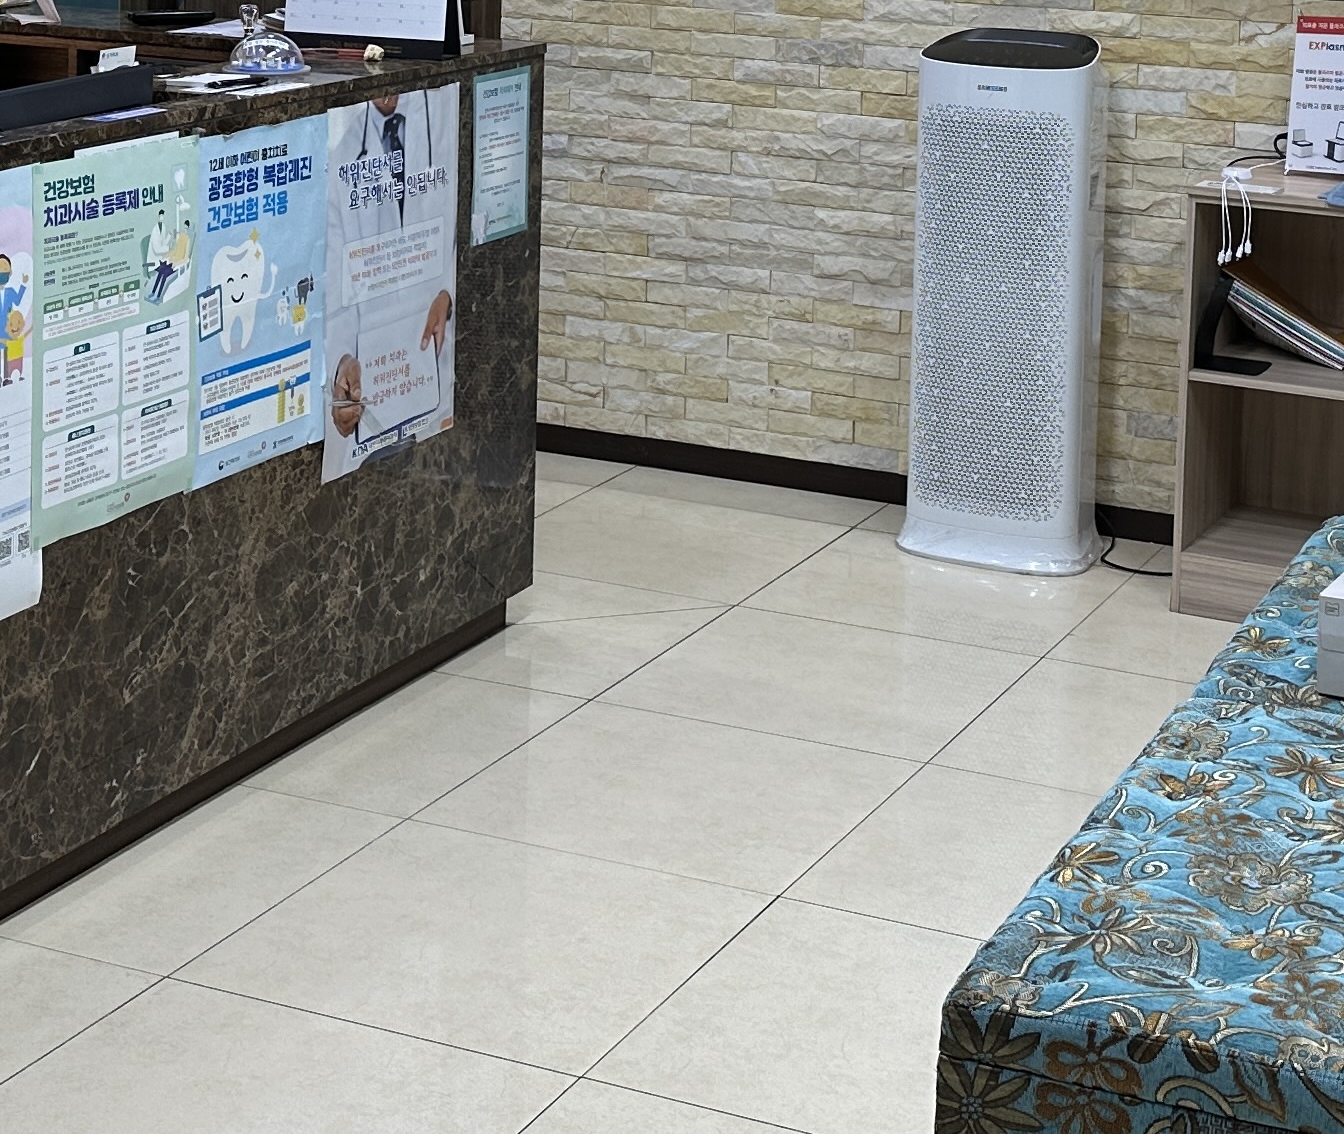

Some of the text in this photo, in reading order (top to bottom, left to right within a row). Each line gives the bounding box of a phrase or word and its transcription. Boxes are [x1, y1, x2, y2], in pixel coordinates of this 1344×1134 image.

[43, 173, 95, 203] 건강보험
[208, 155, 313, 202] 광중합형 복합레진
[338, 150, 404, 184] 허위진단서를
[348, 166, 449, 210] 요구해서는 안됩니다.
[43, 183, 164, 228] 치과시술 등록제 안내
[207, 190, 288, 233] 건강보험 적용
